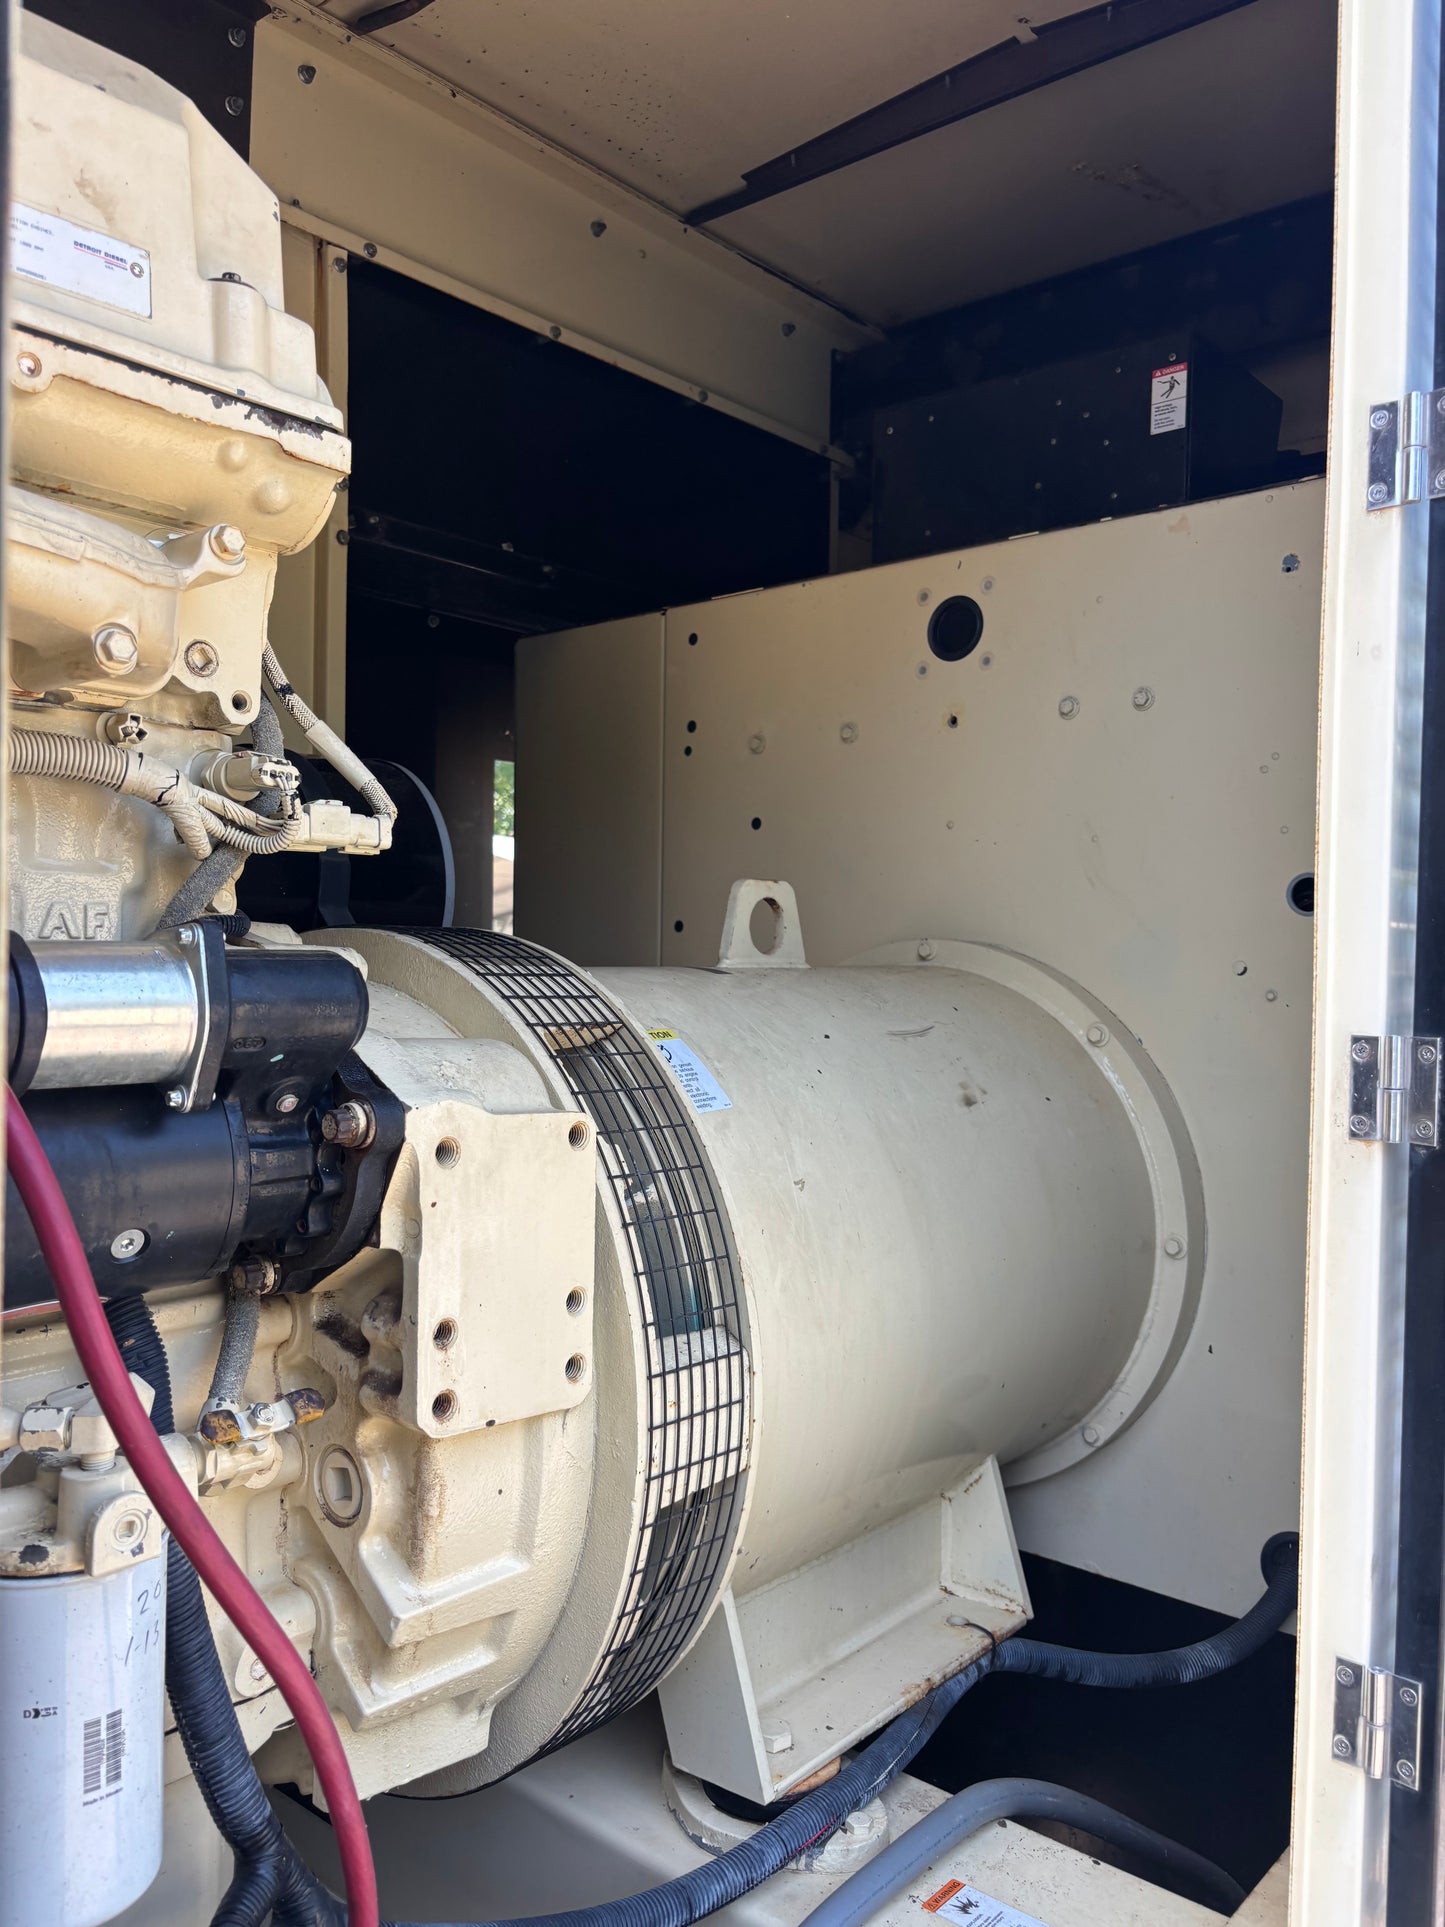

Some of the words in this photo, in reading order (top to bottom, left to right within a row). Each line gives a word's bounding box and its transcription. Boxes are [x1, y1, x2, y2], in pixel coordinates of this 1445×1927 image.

[73, 240, 102, 255] DETROIT
[104, 252, 128, 264] DIESEL
[1162, 365, 1185, 375] DANGER
[38, 900, 110, 940] AF
[933, 1881, 961, 1905] WARNING
